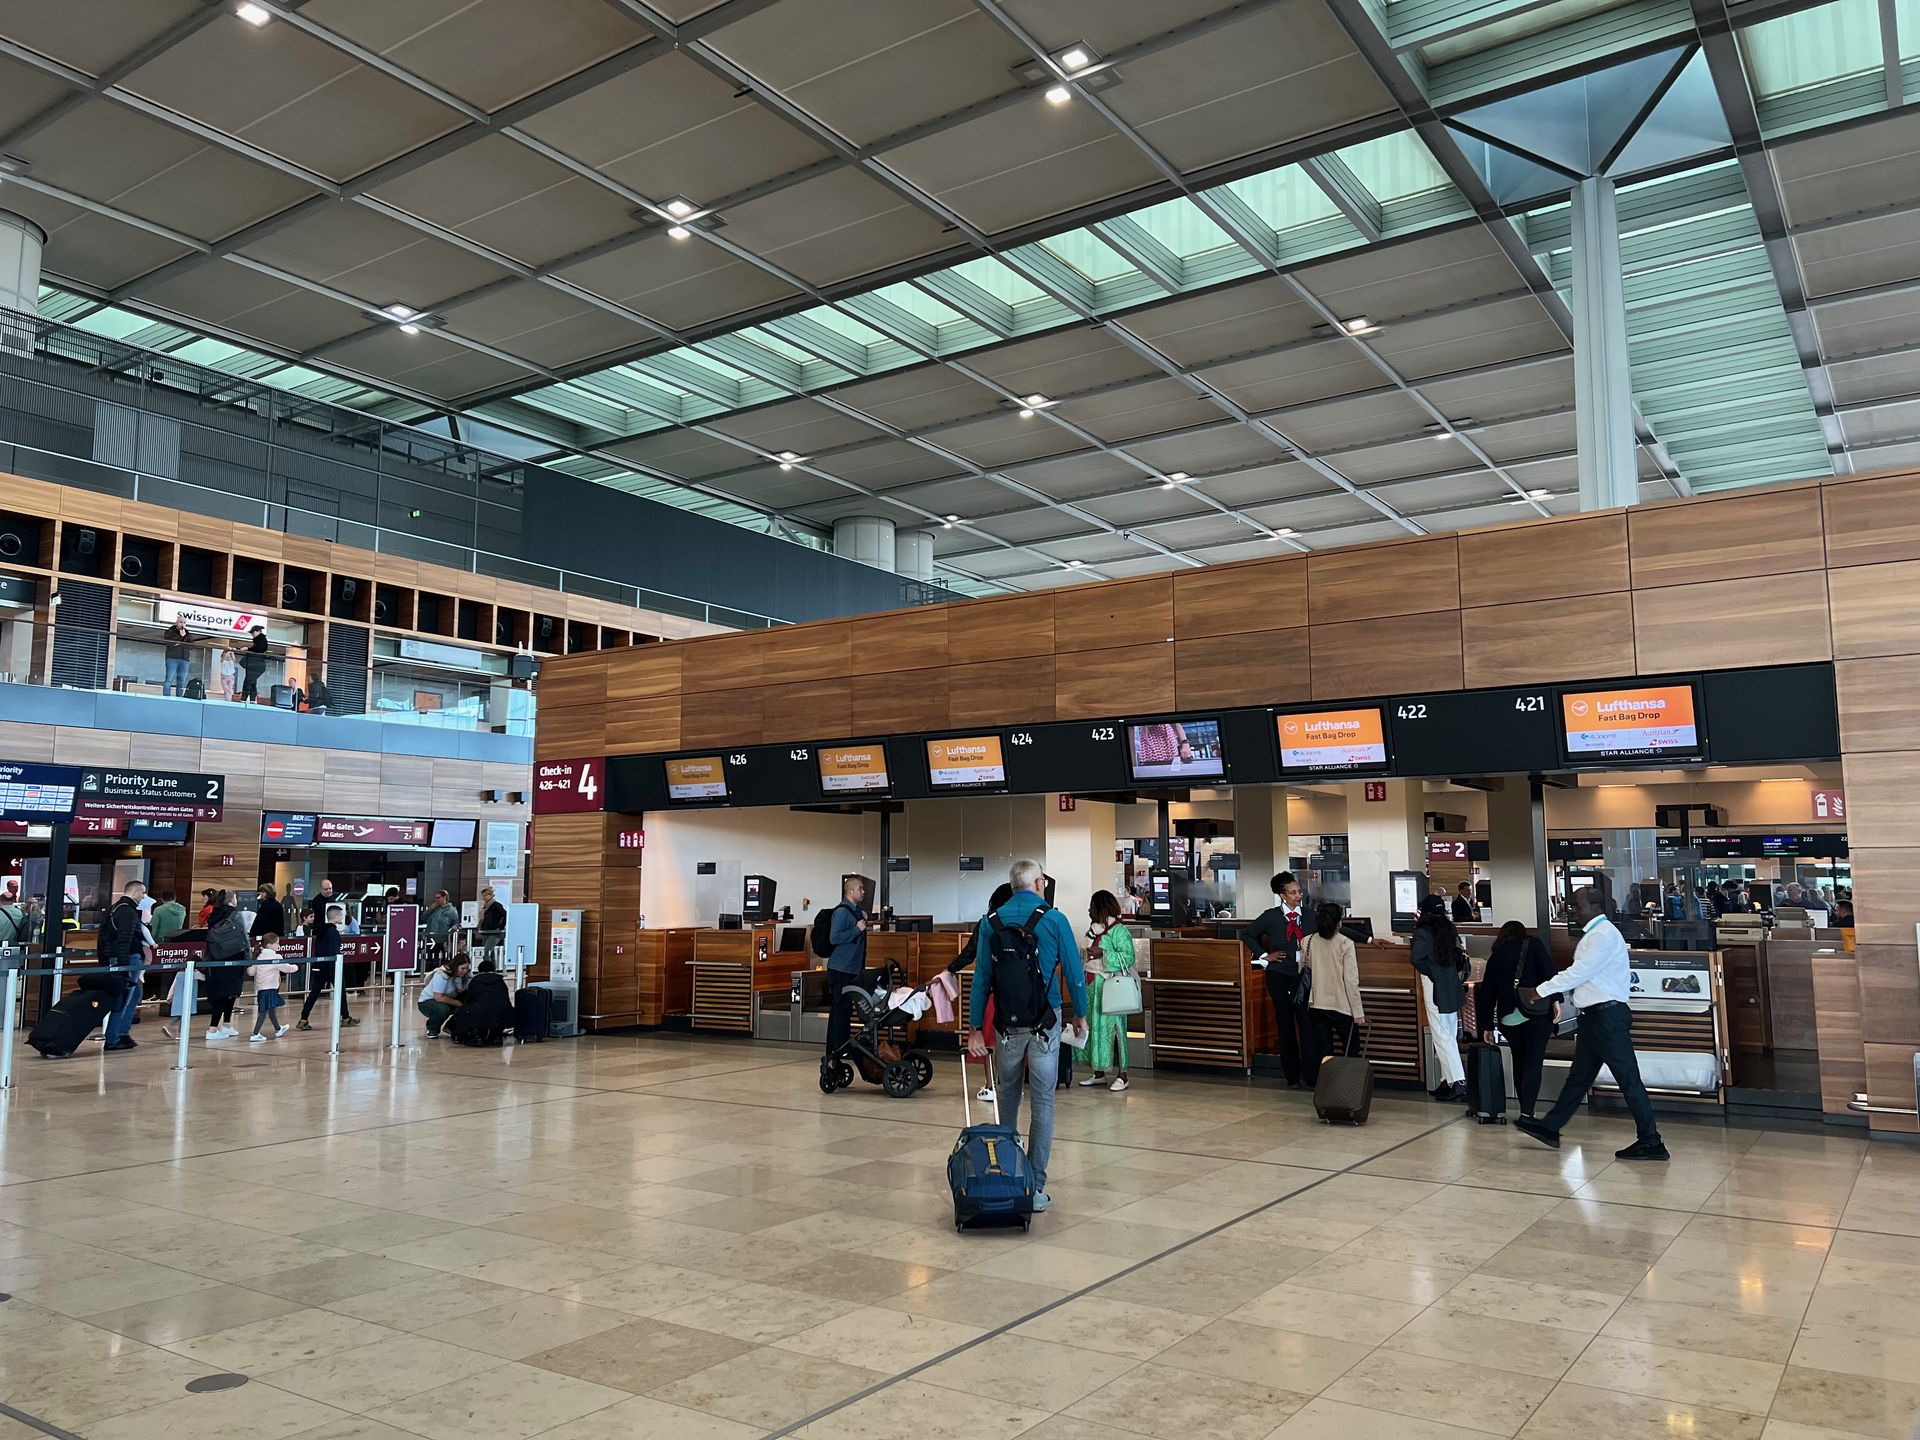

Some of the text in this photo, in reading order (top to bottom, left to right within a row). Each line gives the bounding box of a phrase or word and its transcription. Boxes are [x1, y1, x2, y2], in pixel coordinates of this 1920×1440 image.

[178, 610, 232, 626] swissport
[1515, 696, 1545, 712] 421
[1596, 699, 1666, 713] Lufthansa
[1398, 704, 1428, 720] 422
[1598, 712, 1660, 722] Fast Bag Drop
[1304, 720, 1361, 732] Lufthansa
[1011, 733, 1033, 746] 424
[1092, 728, 1114, 740] 423
[1306, 731, 1356, 740] Fast Bag Drop
[790, 749, 808, 760] 425
[946, 744, 986, 755] Lufthansa
[1620, 748, 1654, 756] ALLIANCE
[730, 754, 747, 765] 426
[835, 753, 872, 763] Lufthansa
[0, 766, 23, 775] riority
[540, 764, 572, 776] Check-in
[105, 774, 178, 788] Priority Lane
[578, 764, 598, 800] 4
[104, 787, 133, 795] Business
[163, 790, 197, 798] Customers
[206, 780, 219, 799] 2
[153, 820, 173, 828] Lane
[322, 822, 354, 831] Alle Gates
[1454, 842, 1465, 858] 2
[340, 942, 356, 951] gang
[156, 949, 189, 957] Eingang
